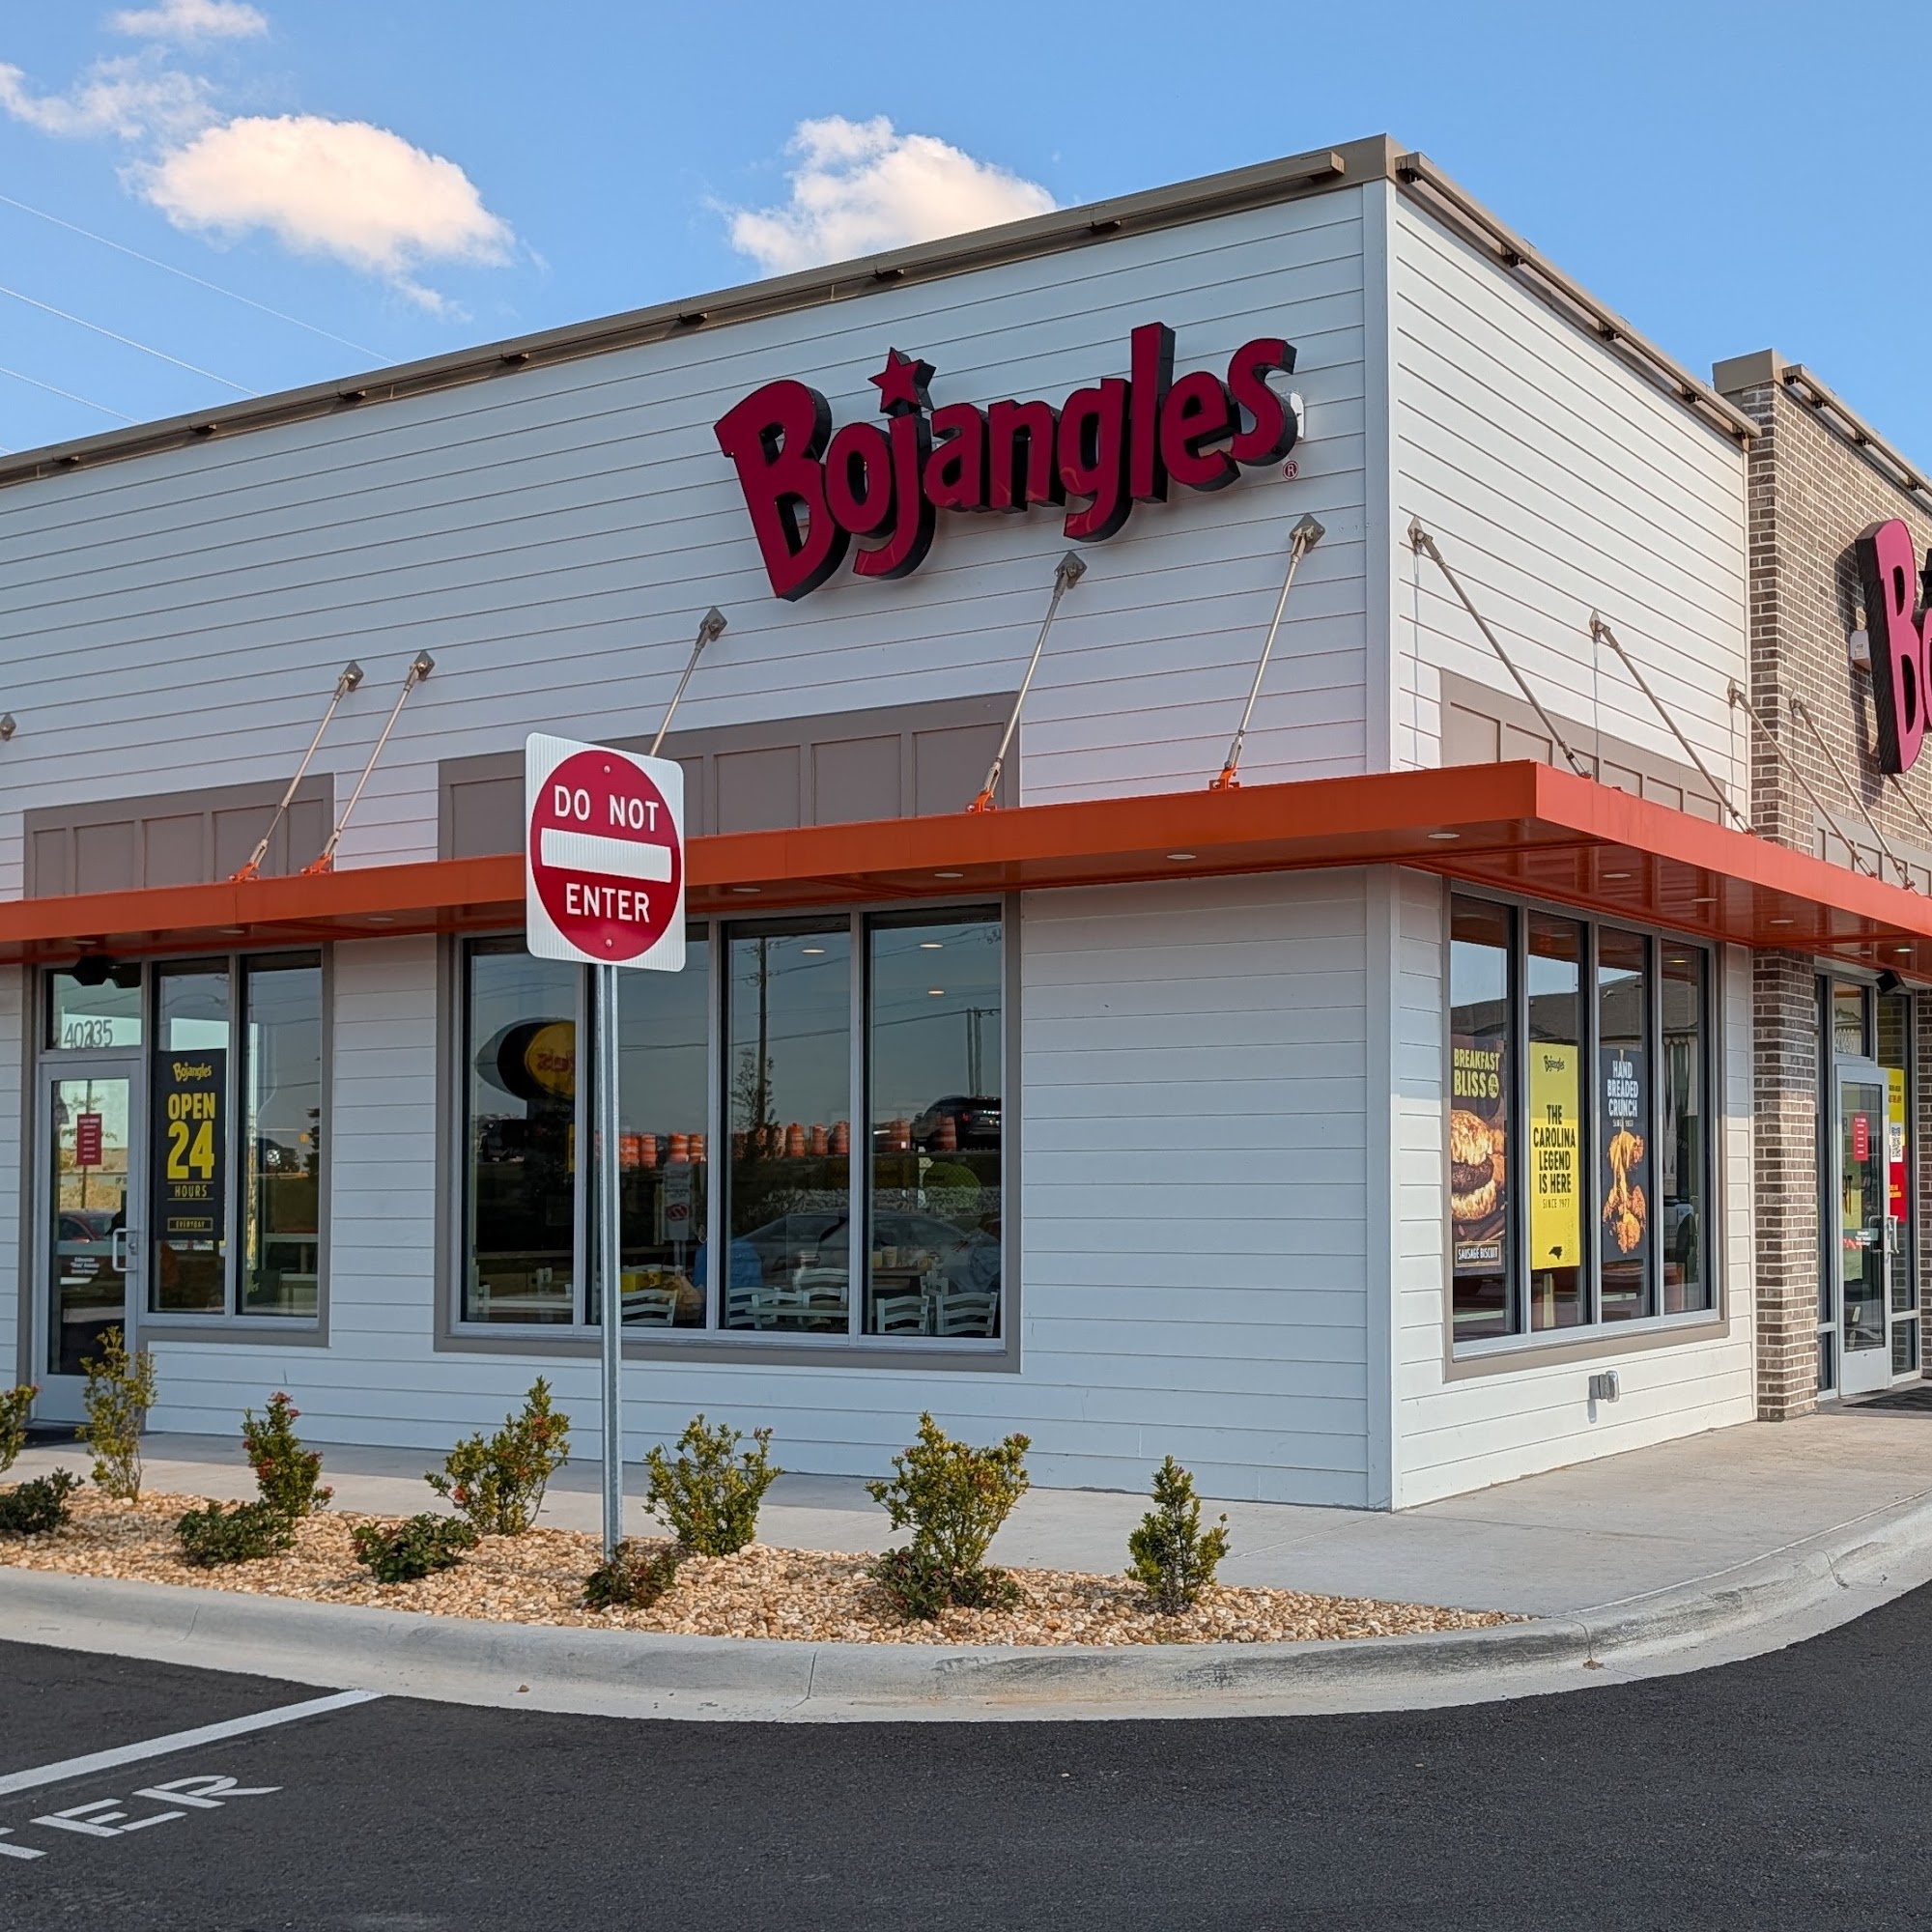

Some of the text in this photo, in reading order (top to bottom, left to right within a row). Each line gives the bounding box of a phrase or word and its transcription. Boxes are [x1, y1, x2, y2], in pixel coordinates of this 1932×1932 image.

[714, 322, 1297, 600] Bojangles
[1856, 518, 1932, 774] B
[554, 785, 659, 832] DO NOT
[566, 883, 650, 923] ENTER
[64, 1019, 113, 1049] 40235
[1454, 1048, 1500, 1071] BREAKFAST
[1612, 1060, 1633, 1079] HAND
[172, 1062, 213, 1082] Bojangles
[1454, 1069, 1487, 1098] BLISS
[1607, 1079, 1638, 1098] BREADED
[168, 1093, 215, 1121] OPEN
[1547, 1104, 1562, 1124] THE
[1608, 1098, 1637, 1118] CRUNCH
[1533, 1126, 1576, 1148] CAROLINA
[167, 1121, 214, 1179] 24
[1539, 1151, 1571, 1171] LEGEND
[175, 1185, 208, 1198] HOURS
[1539, 1174, 1572, 1194] IS HERE
[1543, 1199, 1570, 1208] SINCE 1977
[1458, 1246, 1497, 1260] SAUSAGE BISCUIT
